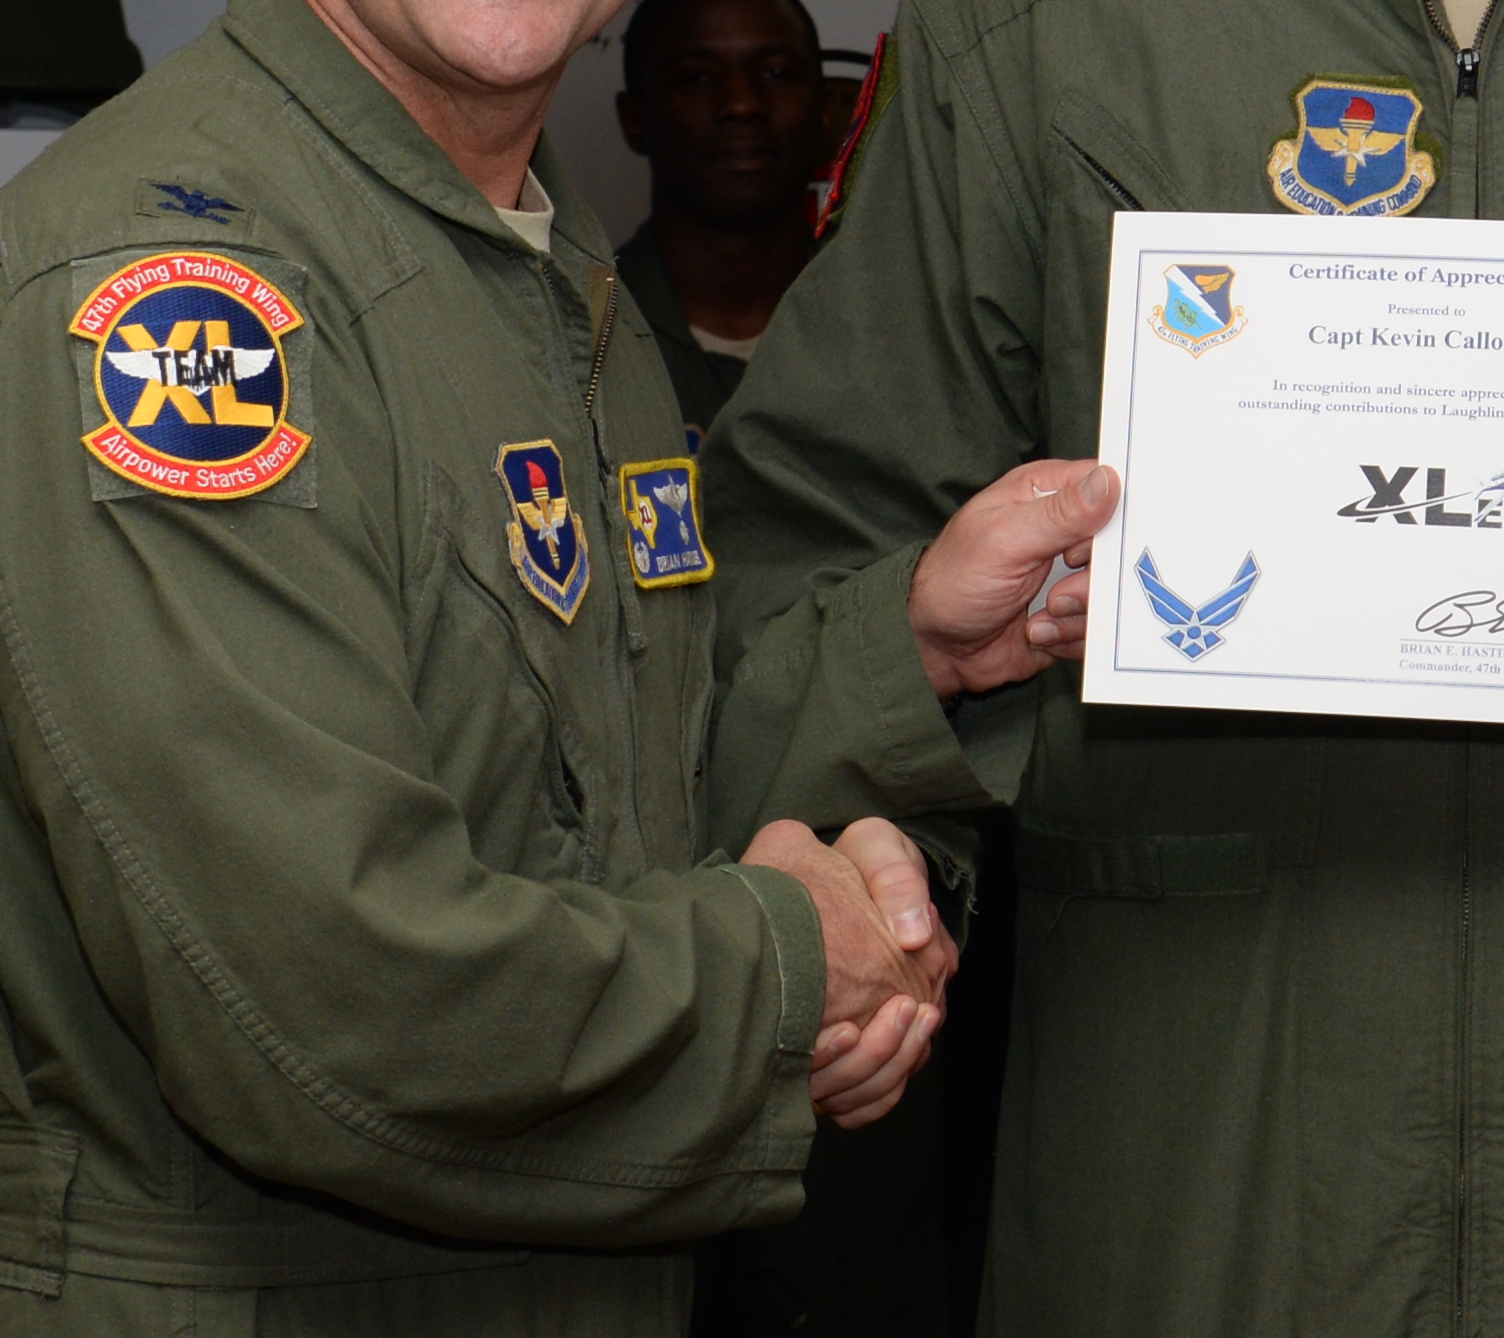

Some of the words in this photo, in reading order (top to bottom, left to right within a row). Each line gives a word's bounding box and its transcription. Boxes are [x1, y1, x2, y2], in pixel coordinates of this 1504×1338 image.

[1289, 263, 1398, 282] Certificate
[1404, 267, 1428, 283] of
[82, 296, 118, 332] 47th
[110, 264, 171, 299] Flying
[170, 258, 251, 293] Training
[251, 283, 290, 328] Wing
[1387, 303, 1450, 317] Presented
[1454, 307, 1466, 317] to
[1308, 325, 1363, 350] Capt
[1370, 327, 1436, 348] Kevin
[117, 320, 275, 428] XL
[152, 349, 238, 387] TEAM
[1272, 379, 1288, 391] In
[1292, 381, 1371, 396] recognition
[1376, 384, 1402, 395] and
[1406, 384, 1456, 397] sincere
[1238, 399, 1322, 415] outstanding
[1325, 402, 1418, 415] contributions
[1423, 405, 1437, 415] to
[1441, 404, 1504, 421] Laughlin
[100, 433, 190, 486] Airpower
[196, 466, 257, 488] Starts
[255, 433, 298, 475] Here!
[1400, 643, 1443, 656] BRIAN
[1446, 645, 1458, 656] E.
[1399, 659, 1473, 674] Commander,
[1476, 663, 1501, 674] 47th
